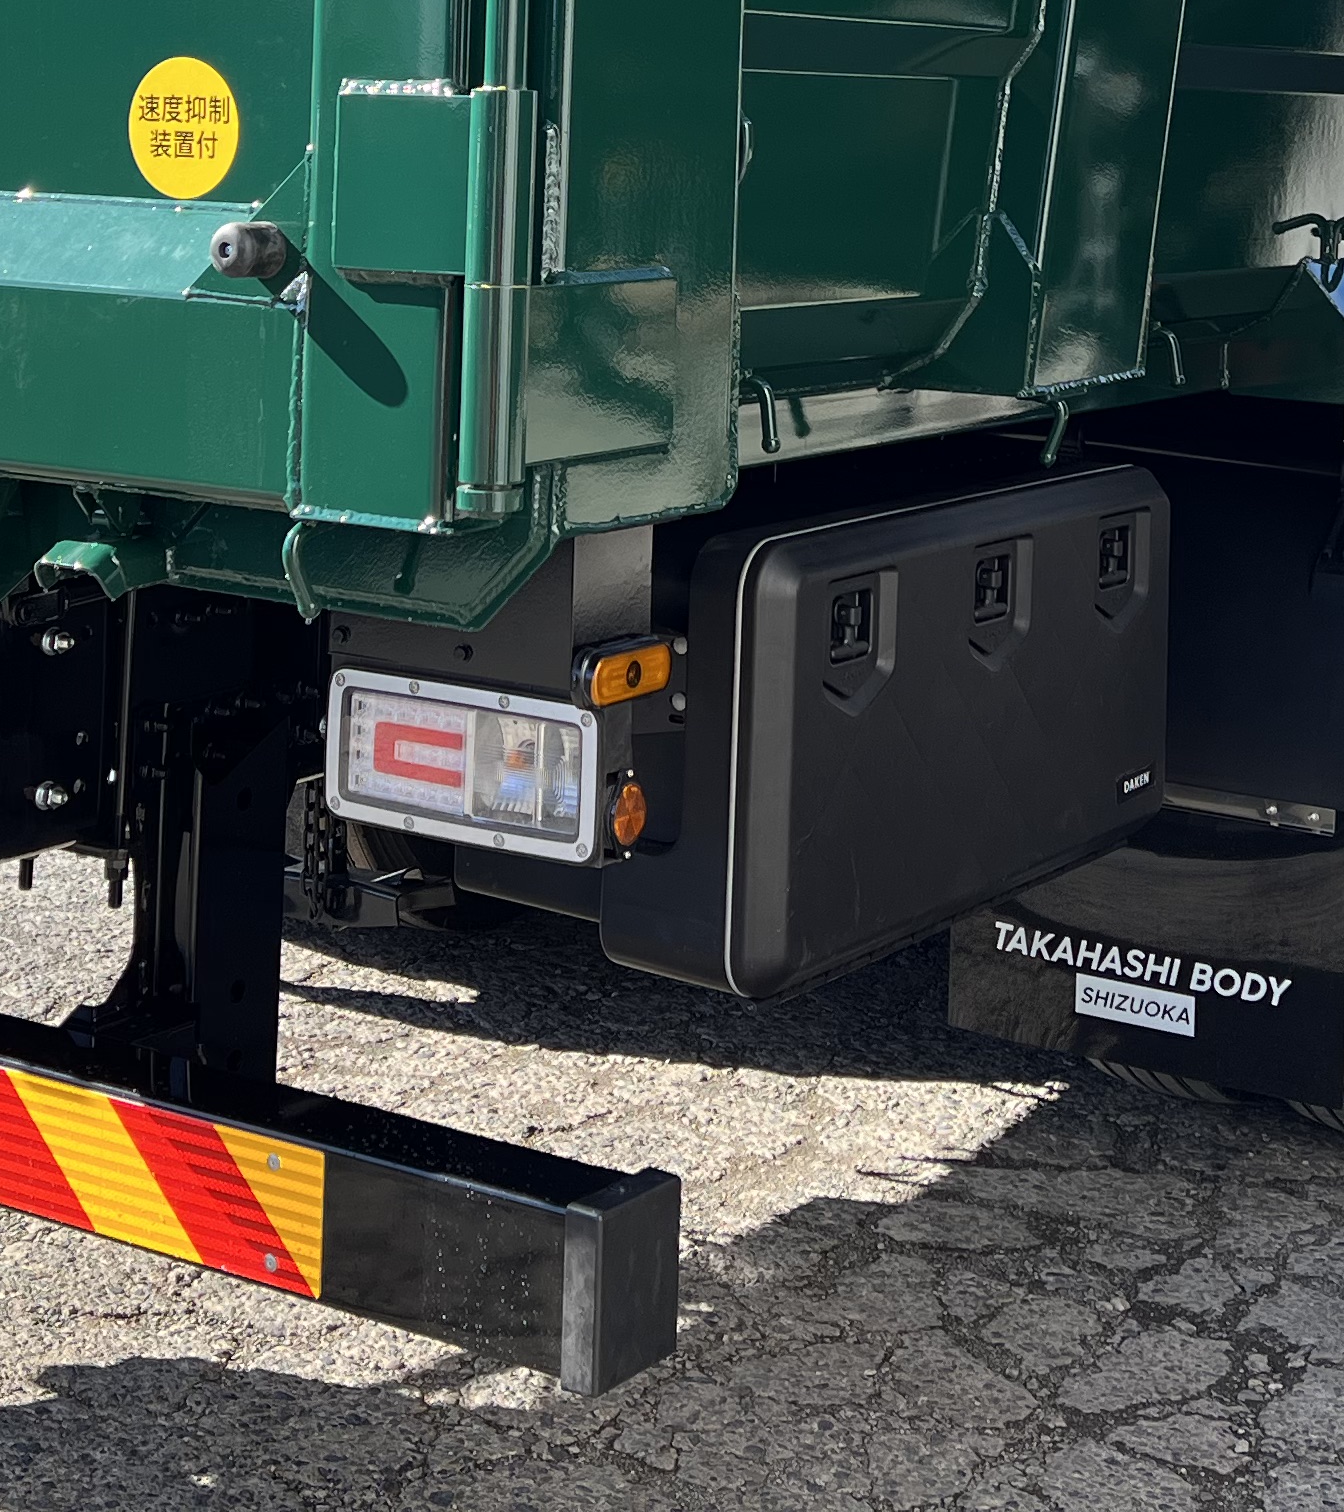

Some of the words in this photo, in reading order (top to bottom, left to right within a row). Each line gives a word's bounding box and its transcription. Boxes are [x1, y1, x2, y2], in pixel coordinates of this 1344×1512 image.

[138, 93, 231, 125] 速度抑制
[149, 129, 219, 160] 装置付
[1123, 770, 1151, 794] DAKEN
[994, 920, 1182, 987] TAKAHASHI
[1189, 961, 1293, 1007] BODY
[1080, 986, 1191, 1026] SHIZUOKA
